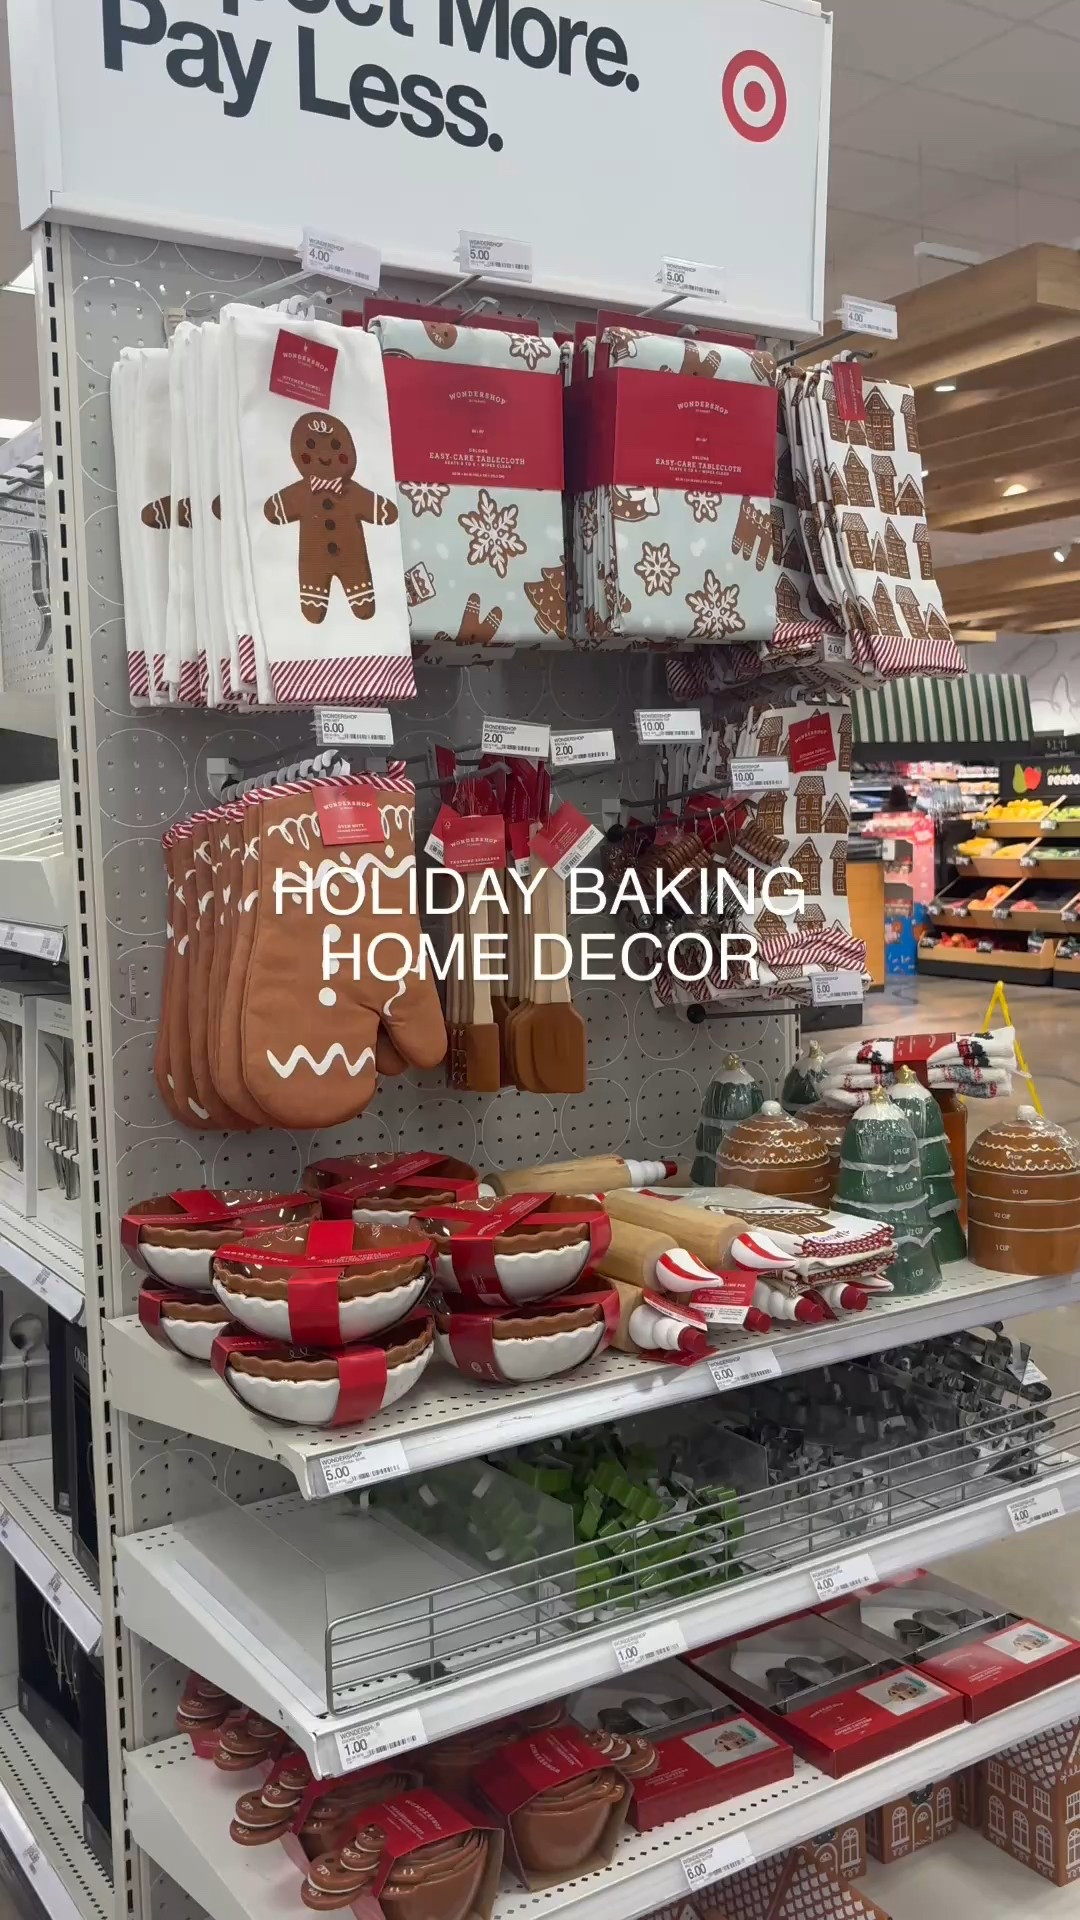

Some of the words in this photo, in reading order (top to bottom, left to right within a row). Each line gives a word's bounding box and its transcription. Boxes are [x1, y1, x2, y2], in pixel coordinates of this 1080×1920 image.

[439, 0, 639, 92] More.
[103, 0, 272, 118] Pay
[298, 25, 503, 152] Less.
[309, 248, 330, 262] 4.00
[470, 249, 490, 261] 5.00
[666, 271, 685, 284] 5.00
[848, 312, 863, 323] 4.00
[449, 390, 506, 405] WONDERSHOP
[677, 401, 729, 415] WONDERSHOP
[429, 452, 474, 461] EASY-CARE
[476, 455, 525, 465] TABLECLOTH
[655, 458, 696, 468] EASY-CARE
[698, 462, 742, 473] TABLECLOTH
[827, 644, 842, 654] 4.00
[323, 723, 344, 733] 6.00
[643, 721, 665, 731] 10.00
[484, 733, 503, 743] 2.00
[555, 745, 573, 756] 2.00
[734, 773, 755, 781] 10.00
[816, 984, 831, 994] 5.00
[714, 1368, 733, 1381] 6.00
[321, 1451, 362, 1465] WONDERSHOP
[325, 1466, 350, 1481] 5.00
[1014, 1509, 1029, 1521] 4.00
[816, 1577, 834, 1590] 4.00
[618, 1646, 638, 1661] 1.00
[344, 1739, 368, 1755] 1.00
[686, 1863, 707, 1880] 6.00
